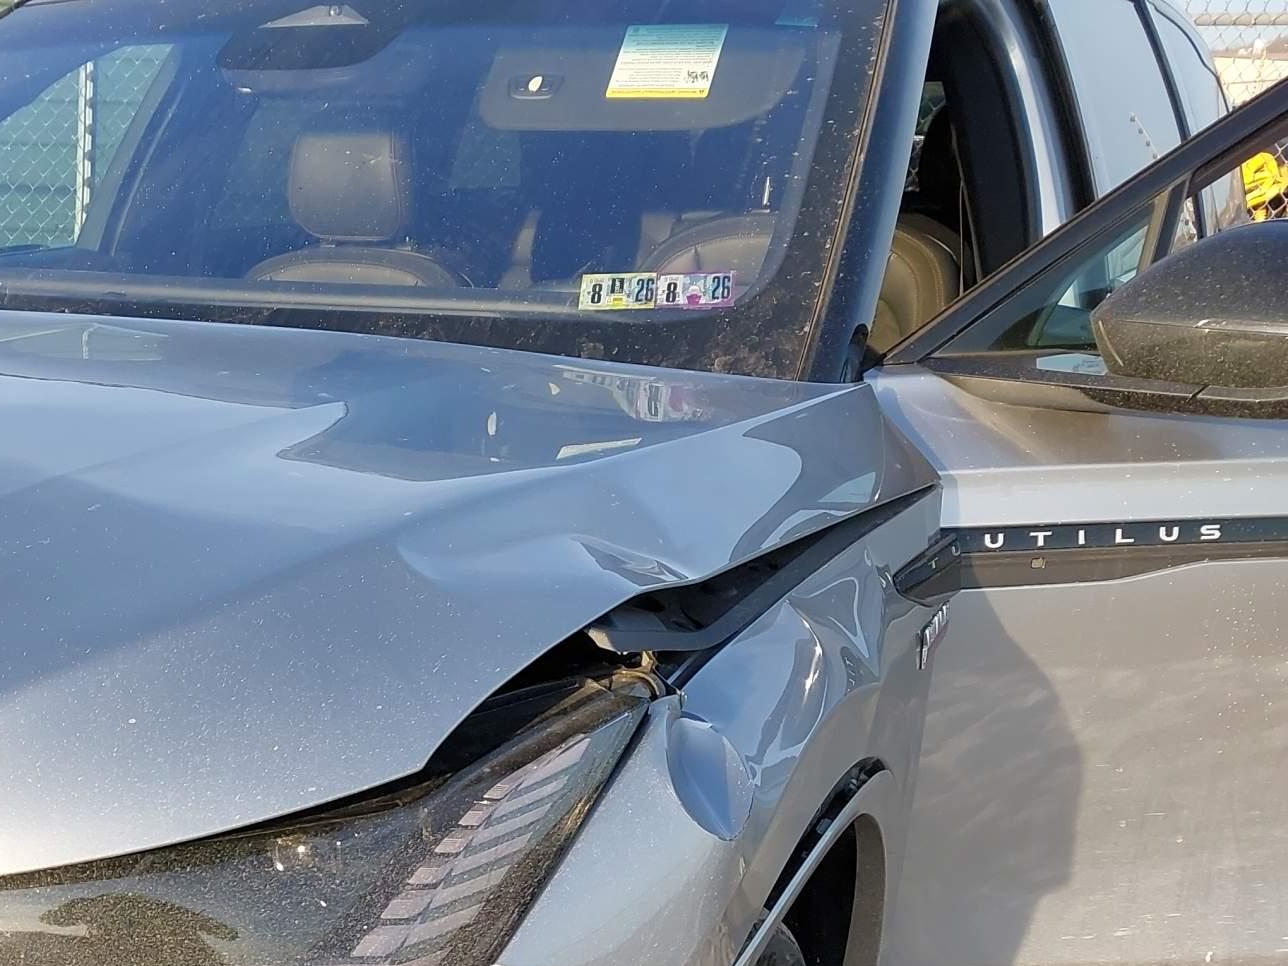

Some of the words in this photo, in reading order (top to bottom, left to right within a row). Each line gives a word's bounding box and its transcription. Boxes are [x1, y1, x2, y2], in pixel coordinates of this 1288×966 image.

[590, 282, 604, 304] 8
[634, 278, 655, 303] 26
[665, 281, 679, 304] 8
[711, 275, 731, 300] 26
